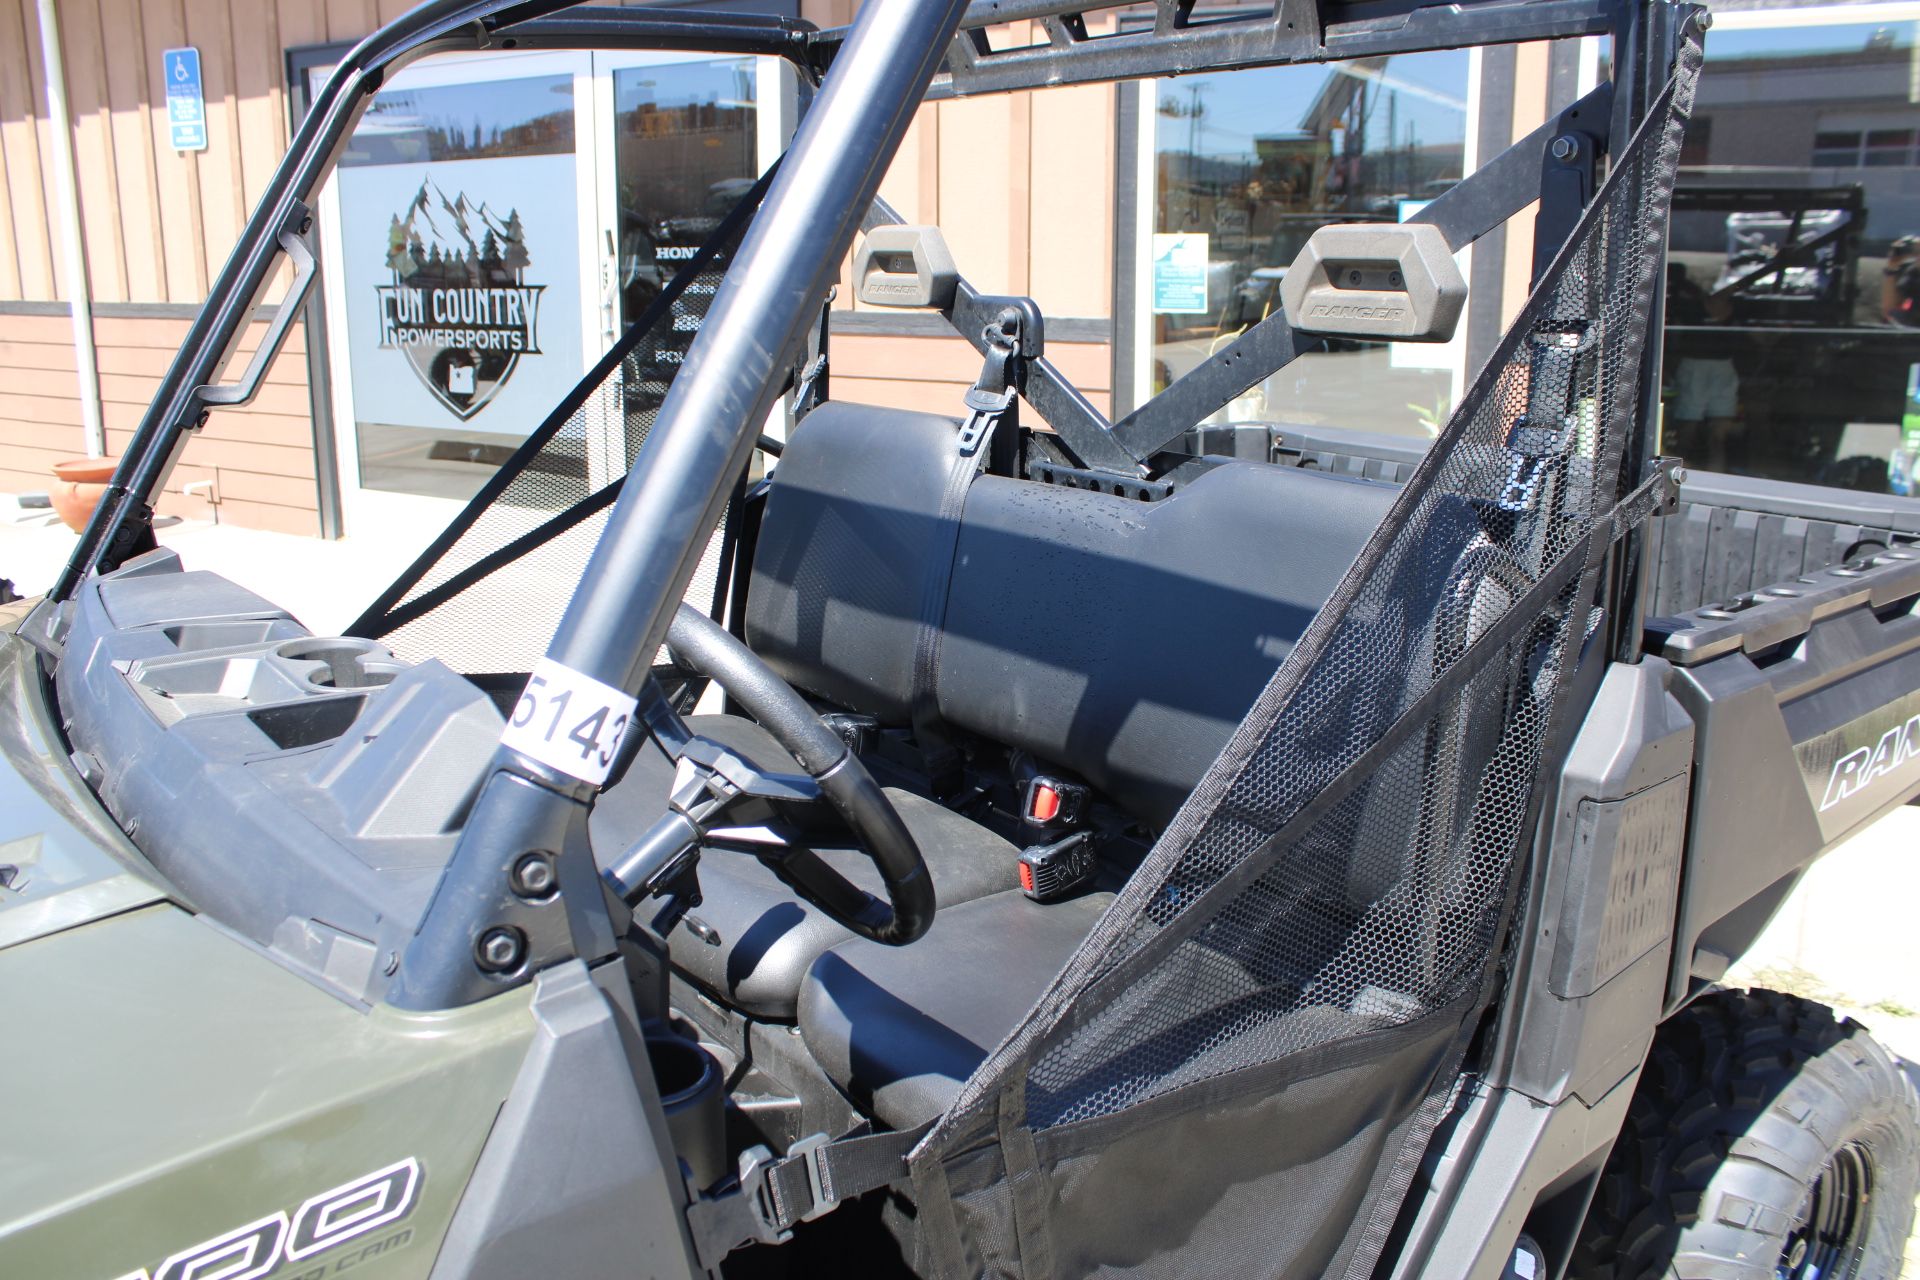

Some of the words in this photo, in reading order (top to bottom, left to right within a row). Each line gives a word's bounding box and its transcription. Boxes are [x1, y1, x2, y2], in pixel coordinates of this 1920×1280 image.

[869, 284, 919, 296] RANGER
[378, 287, 425, 346] FUN
[432, 287, 541, 352] COUNTRY
[1310, 305, 1405, 321] RANGER
[398, 327, 523, 350] POWERSPORTS
[513, 675, 627, 768] 5143
[336, 1228, 413, 1271] CAM
